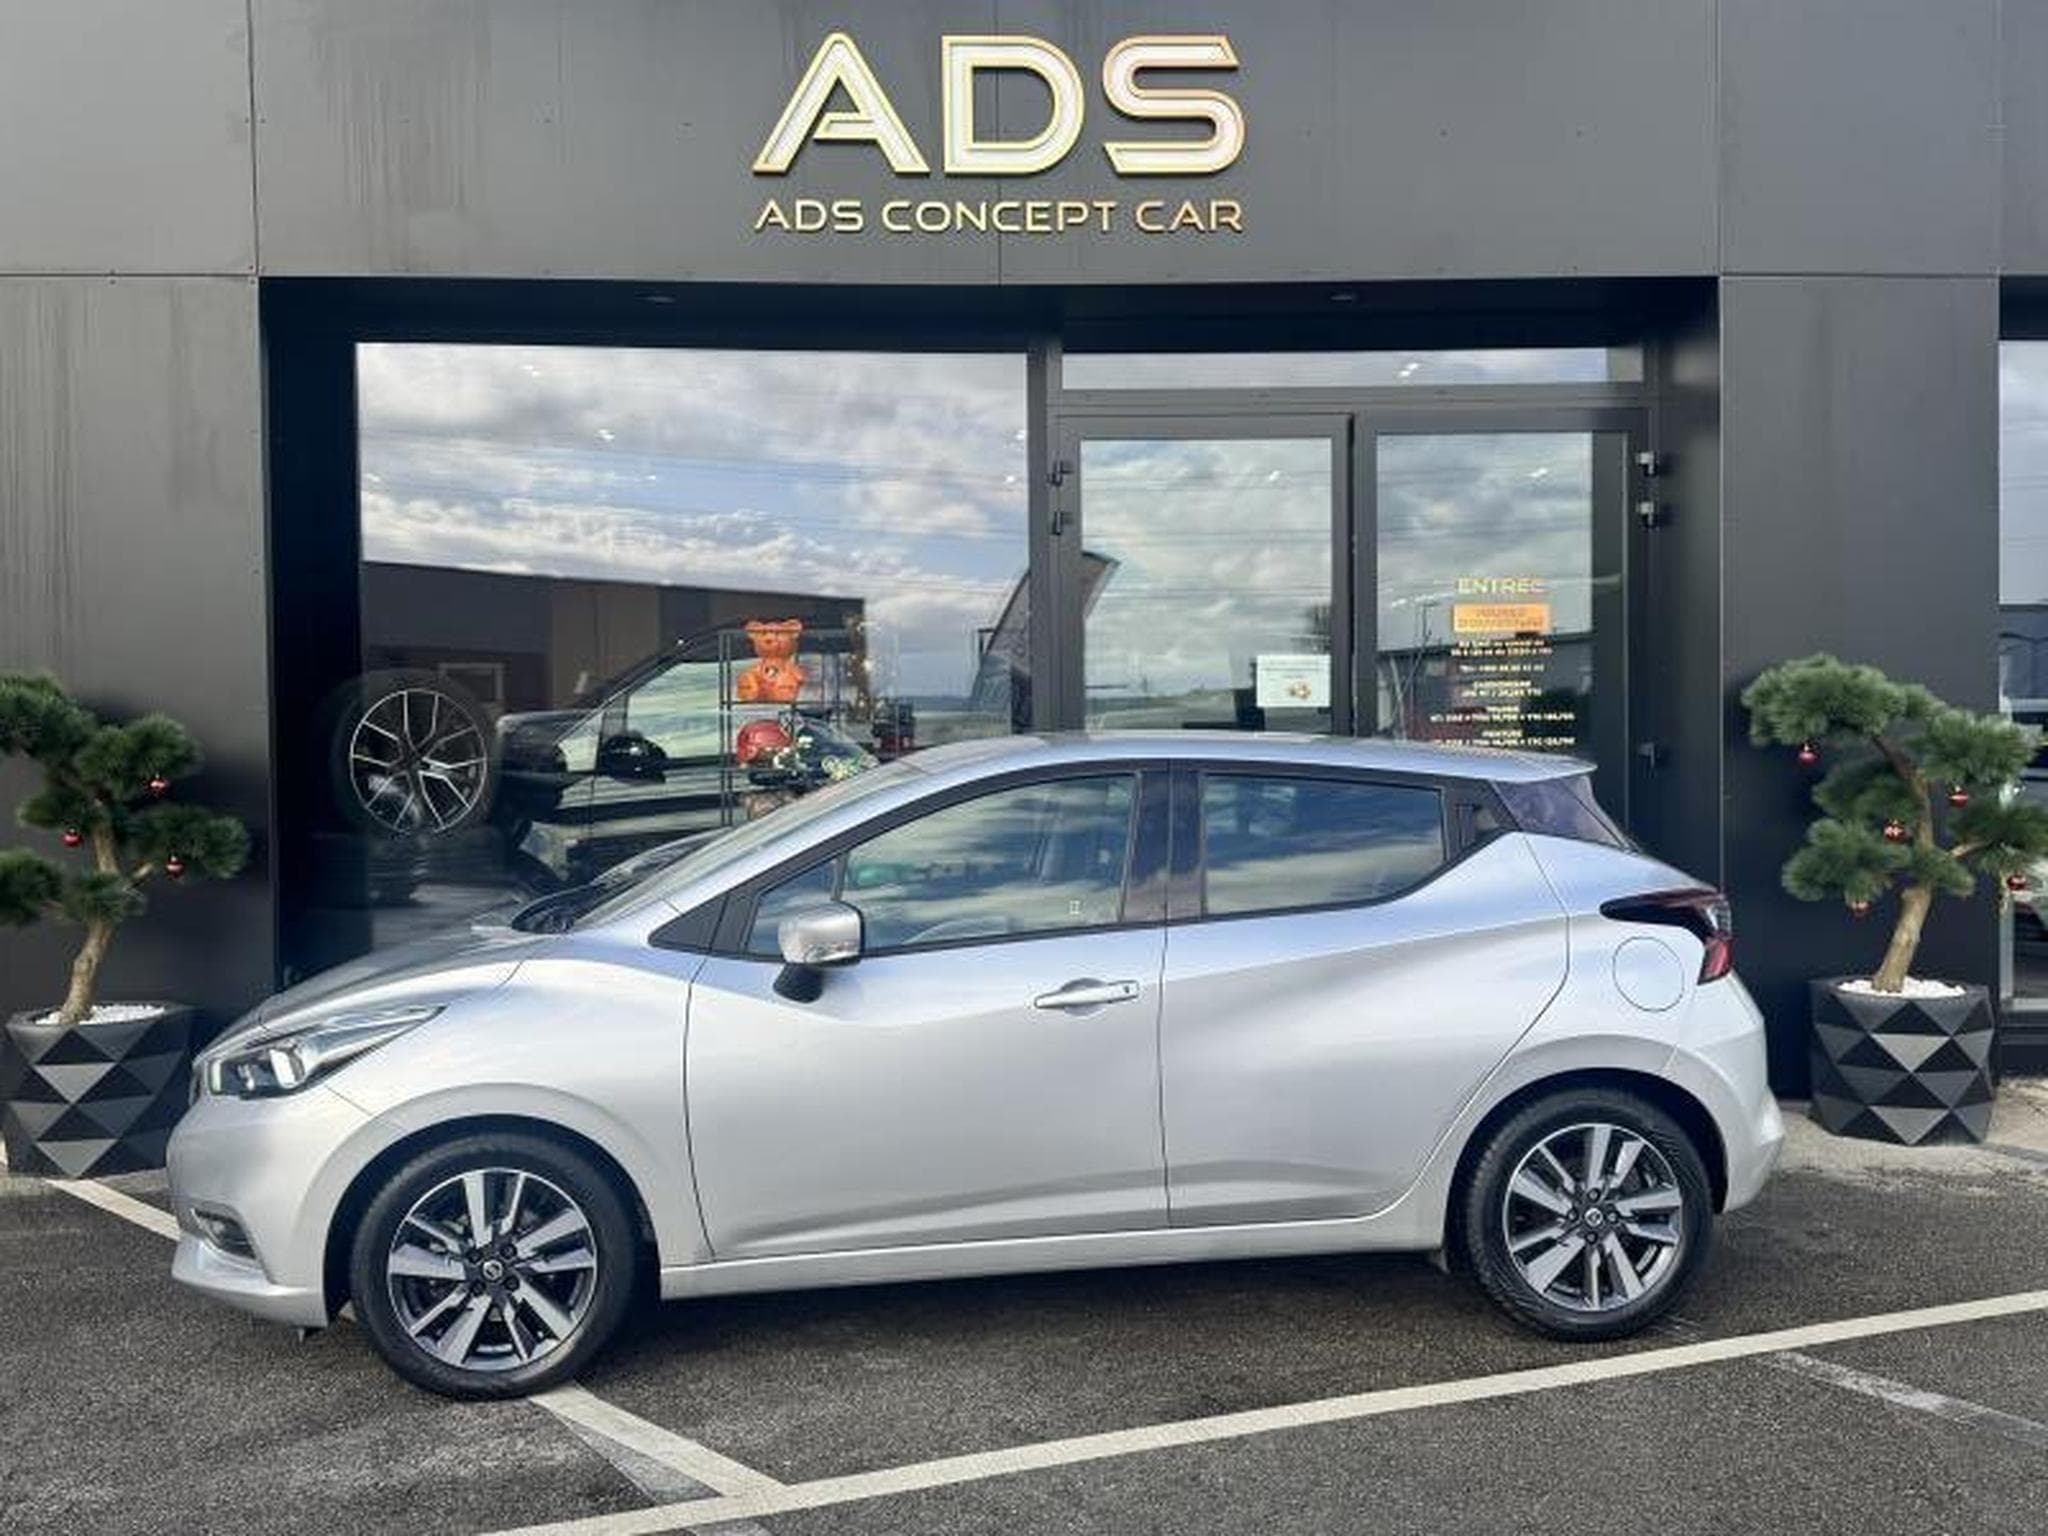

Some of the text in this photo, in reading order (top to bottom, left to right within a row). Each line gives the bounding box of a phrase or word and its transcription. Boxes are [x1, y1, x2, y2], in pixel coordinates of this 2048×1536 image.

[752, 31, 1246, 175] ADS
[754, 199, 1244, 234] ADS CONCEPT CAR
